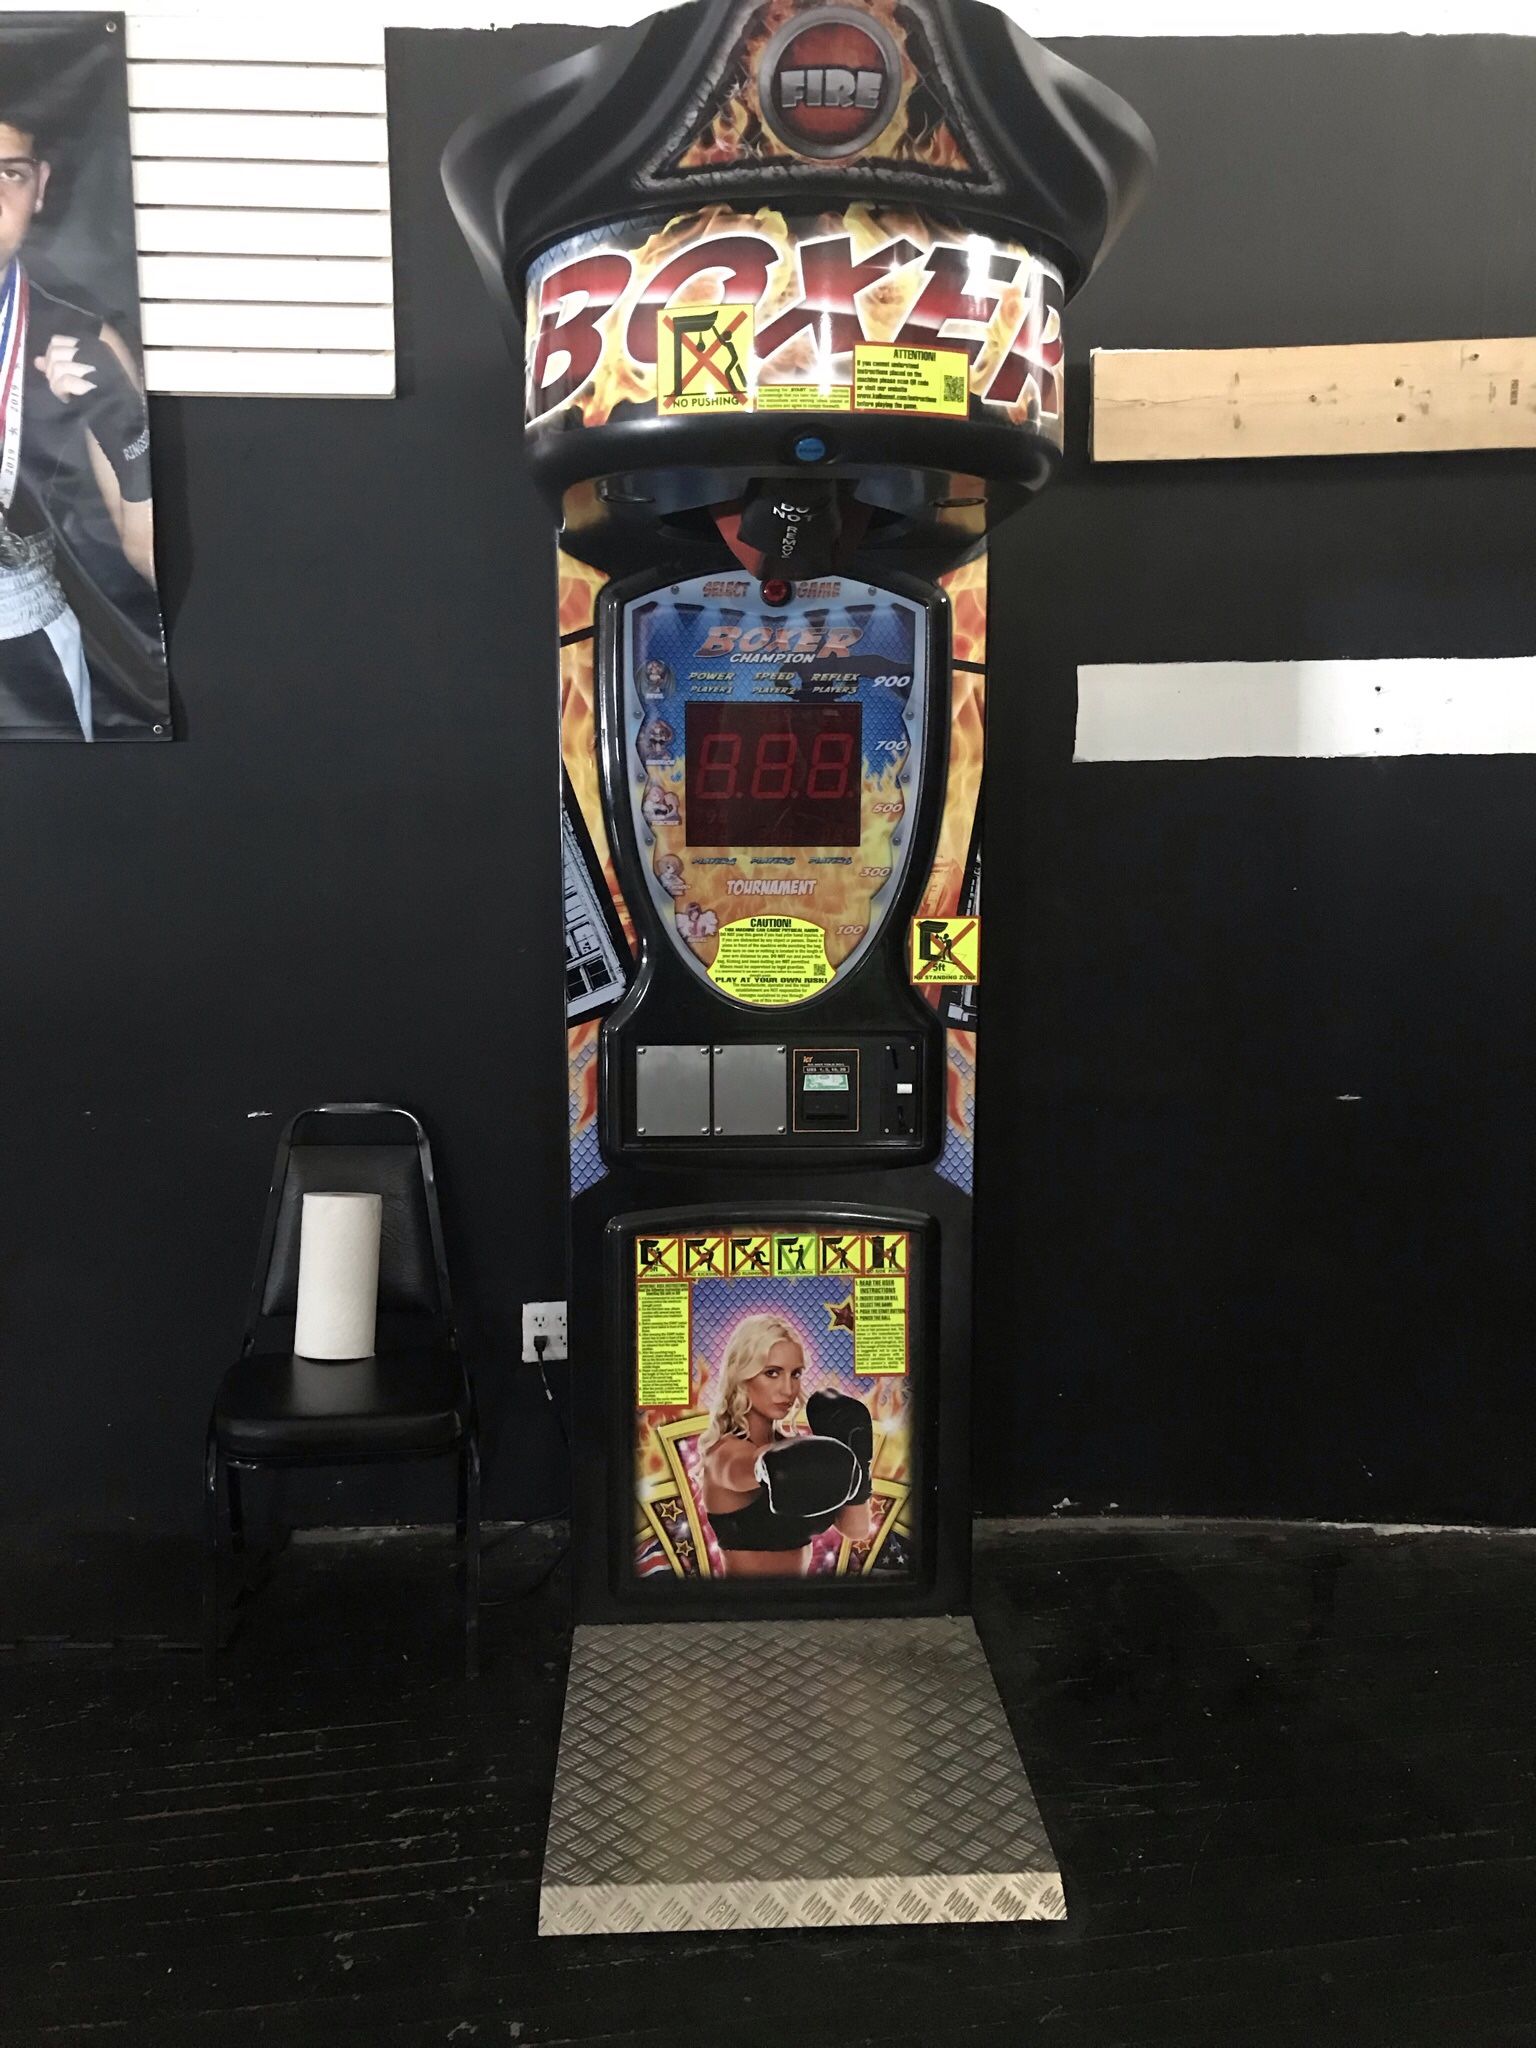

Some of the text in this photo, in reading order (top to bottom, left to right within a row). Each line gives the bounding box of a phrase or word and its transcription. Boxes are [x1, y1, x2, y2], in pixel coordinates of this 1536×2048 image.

[781, 69, 881, 108] FIRE
[526, 233, 1065, 428] BOXER
[893, 349, 936, 361] ATTENTION!
[673, 397, 738, 408] NO PUSHING
[5, 448, 16, 475] 2019
[703, 581, 842, 598] SELECT GAME
[694, 626, 864, 658] BOXER
[729, 653, 815, 663] CHAMPION
[688, 672, 860, 682] POWER SPEED REFLEX
[872, 675, 911, 688] 900
[875, 740, 907, 751] 700
[860, 867, 890, 877] 300
[726, 879, 817, 896] TOURNAMENT
[750, 918, 791, 928] CAUTION!
[836, 925, 863, 935] 100
